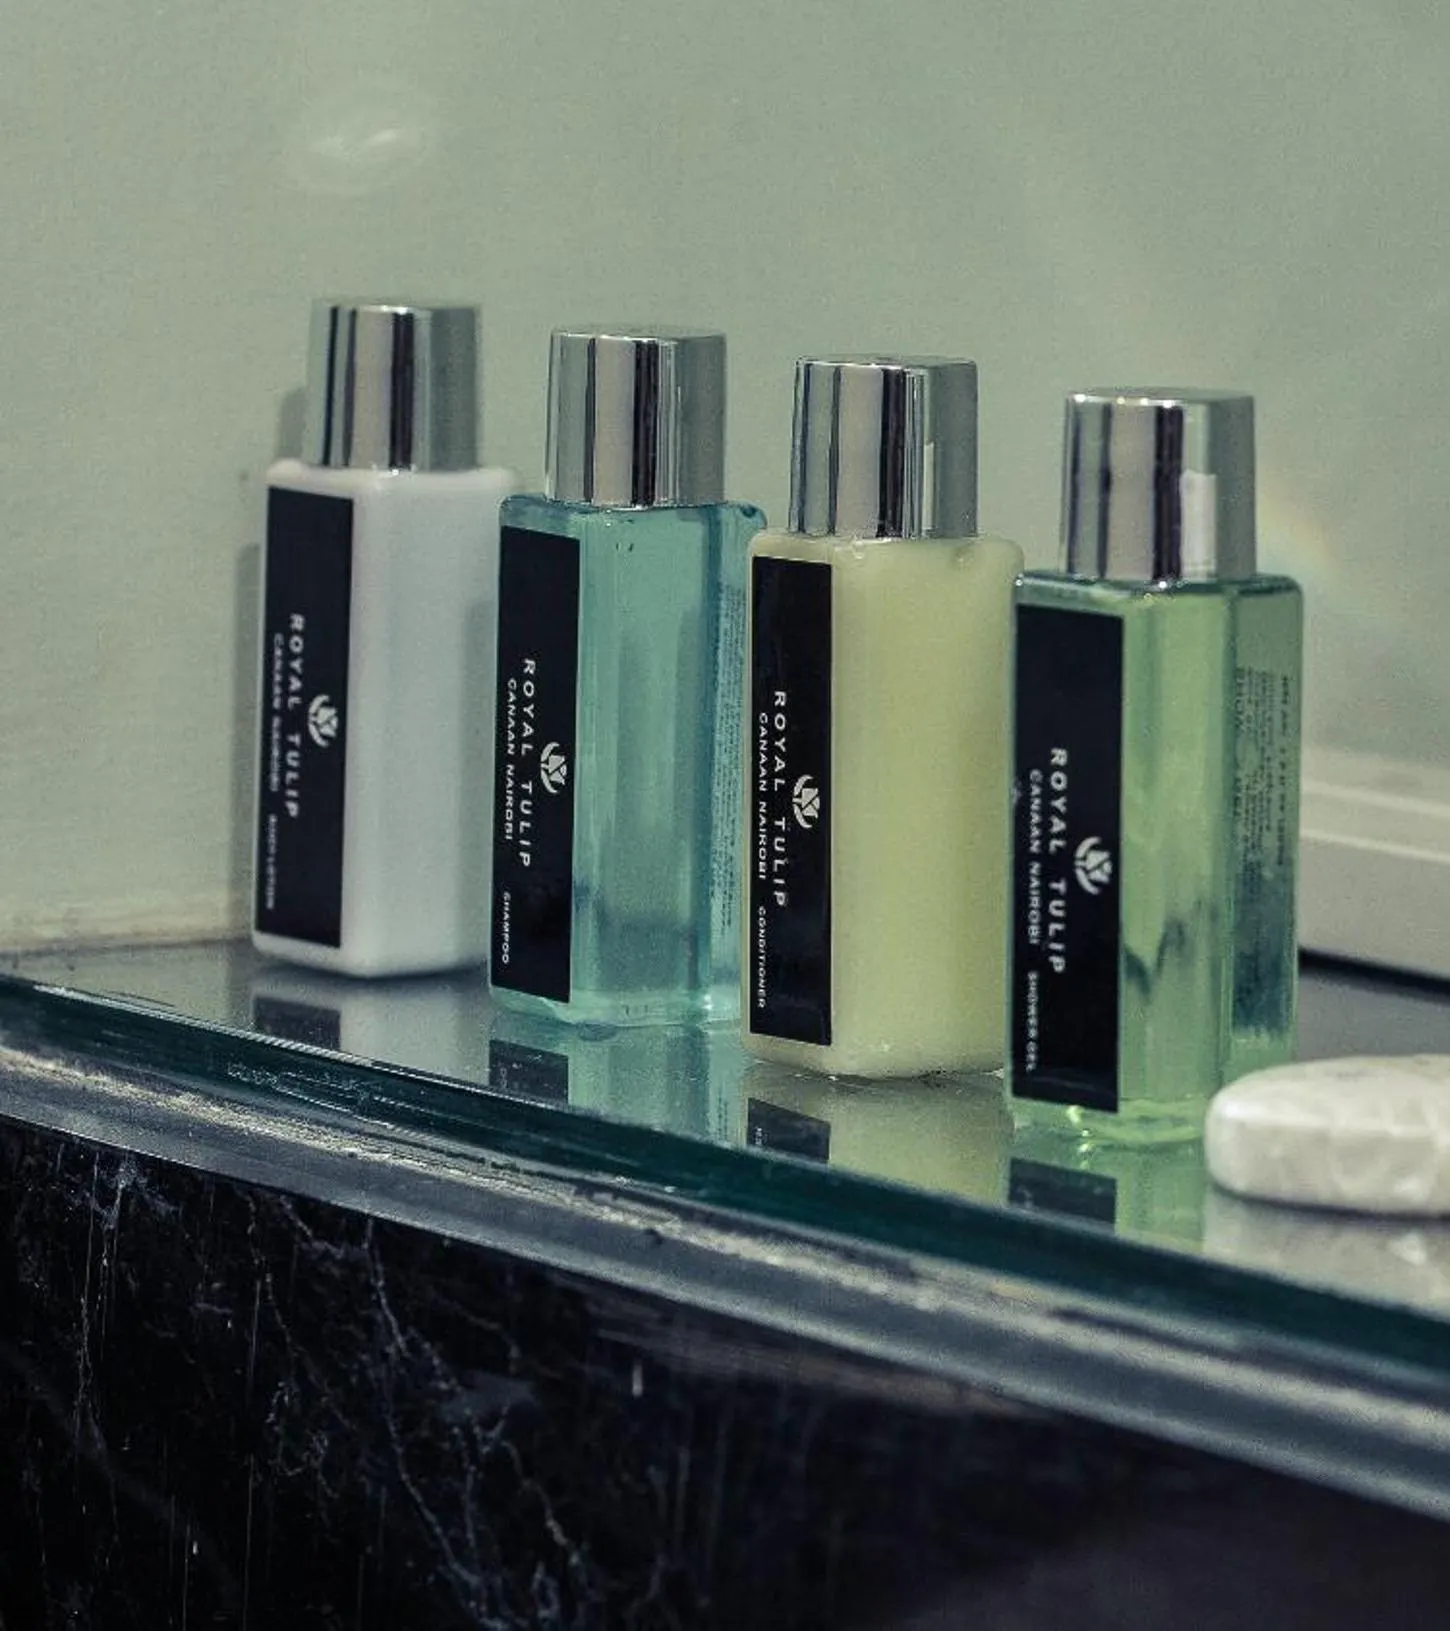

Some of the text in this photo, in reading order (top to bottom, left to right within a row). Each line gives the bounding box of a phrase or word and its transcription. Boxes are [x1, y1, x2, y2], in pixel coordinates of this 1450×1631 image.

[285, 614, 305, 818] ROYAL TULIP
[505, 678, 518, 840] CANAAN NAIROBI
[519, 658, 537, 867] ROYAL TULIP
[758, 712, 769, 879] CANAAN NAIROBI
[773, 691, 787, 907] ROYAL TULIP
[502, 891, 512, 964] SHAMPOO
[1028, 770, 1042, 945] CANAAN NAIROBI
[1048, 748, 1068, 974] ROYAL TULIP
[757, 906, 767, 1008] CONDITIONER
[1025, 971, 1039, 1073] SHOWER GEL
